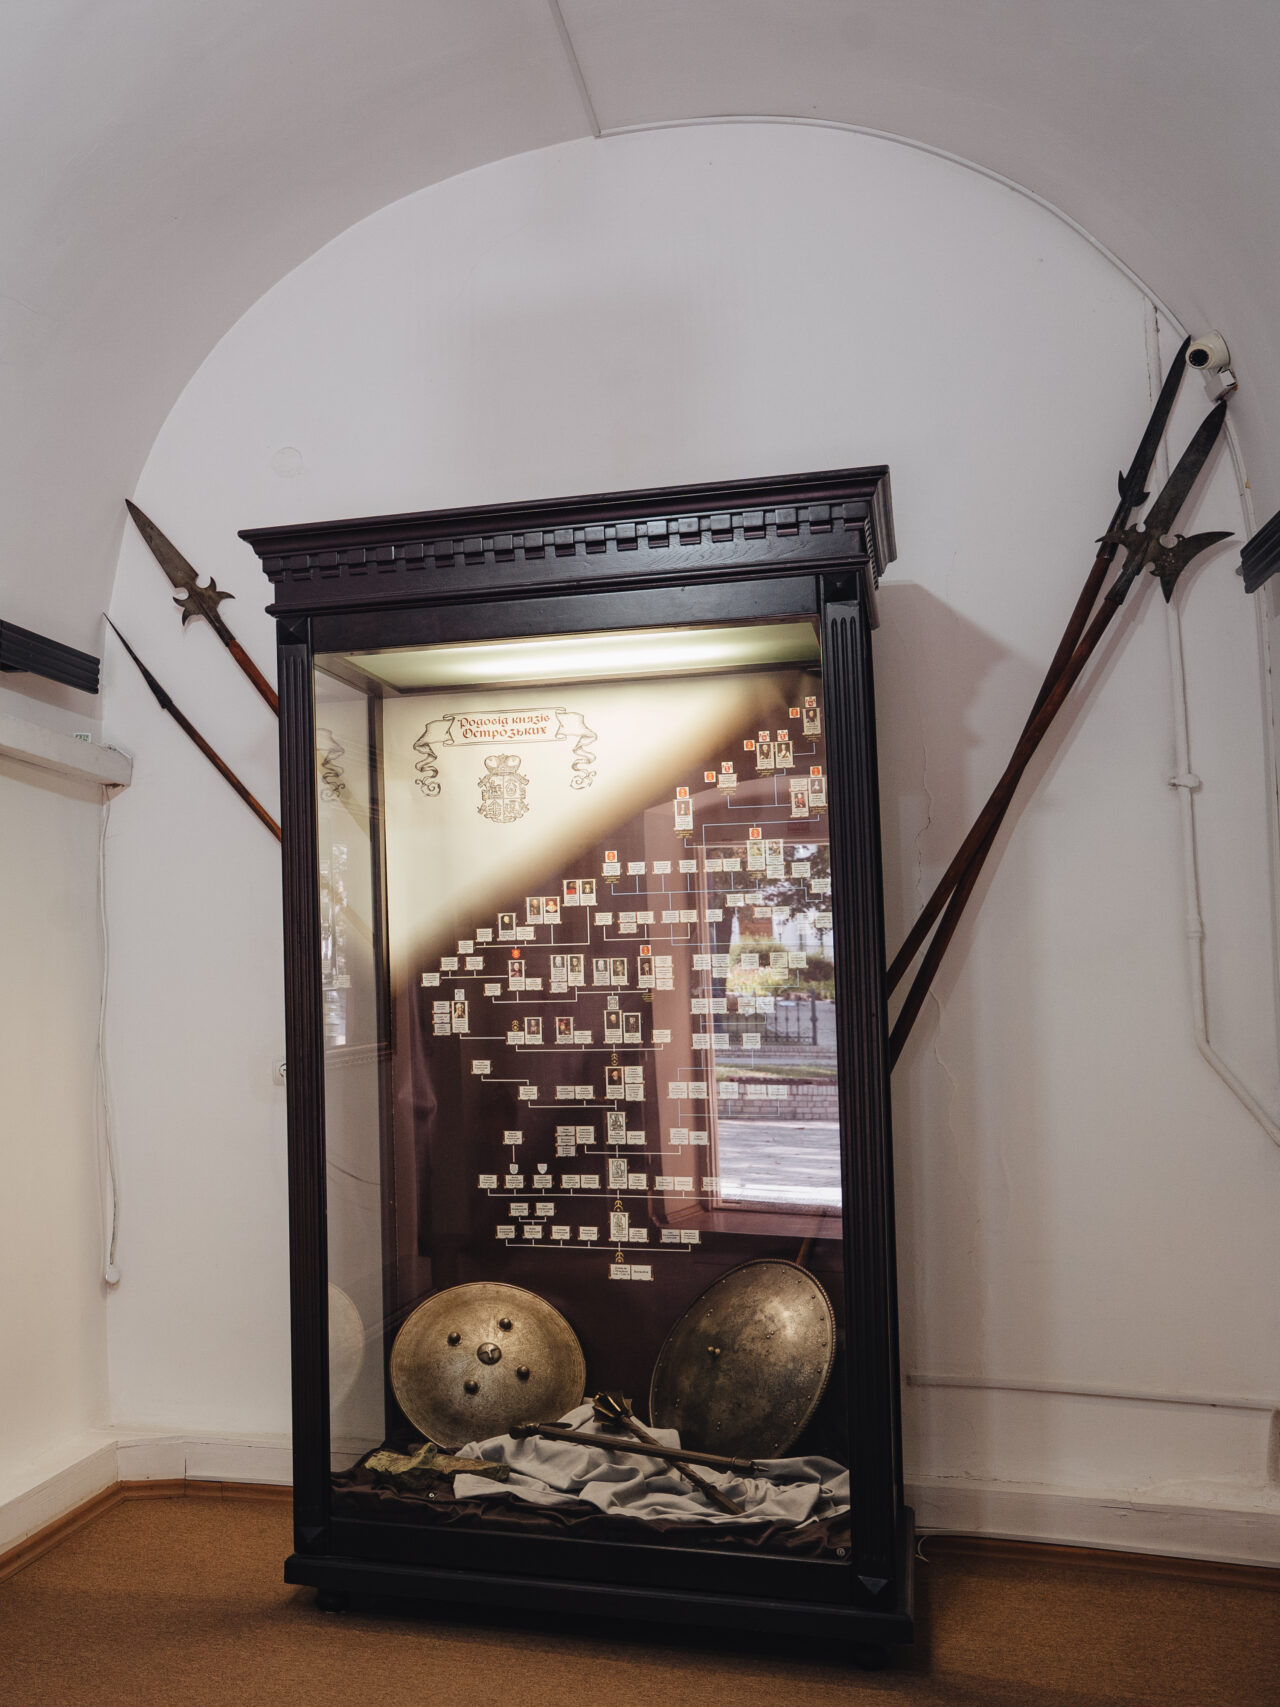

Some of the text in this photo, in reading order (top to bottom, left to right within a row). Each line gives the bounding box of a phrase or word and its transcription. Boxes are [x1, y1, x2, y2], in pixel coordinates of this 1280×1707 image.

[457, 713, 550, 729] Родовід князів
[462, 726, 547, 739] Острозьких
